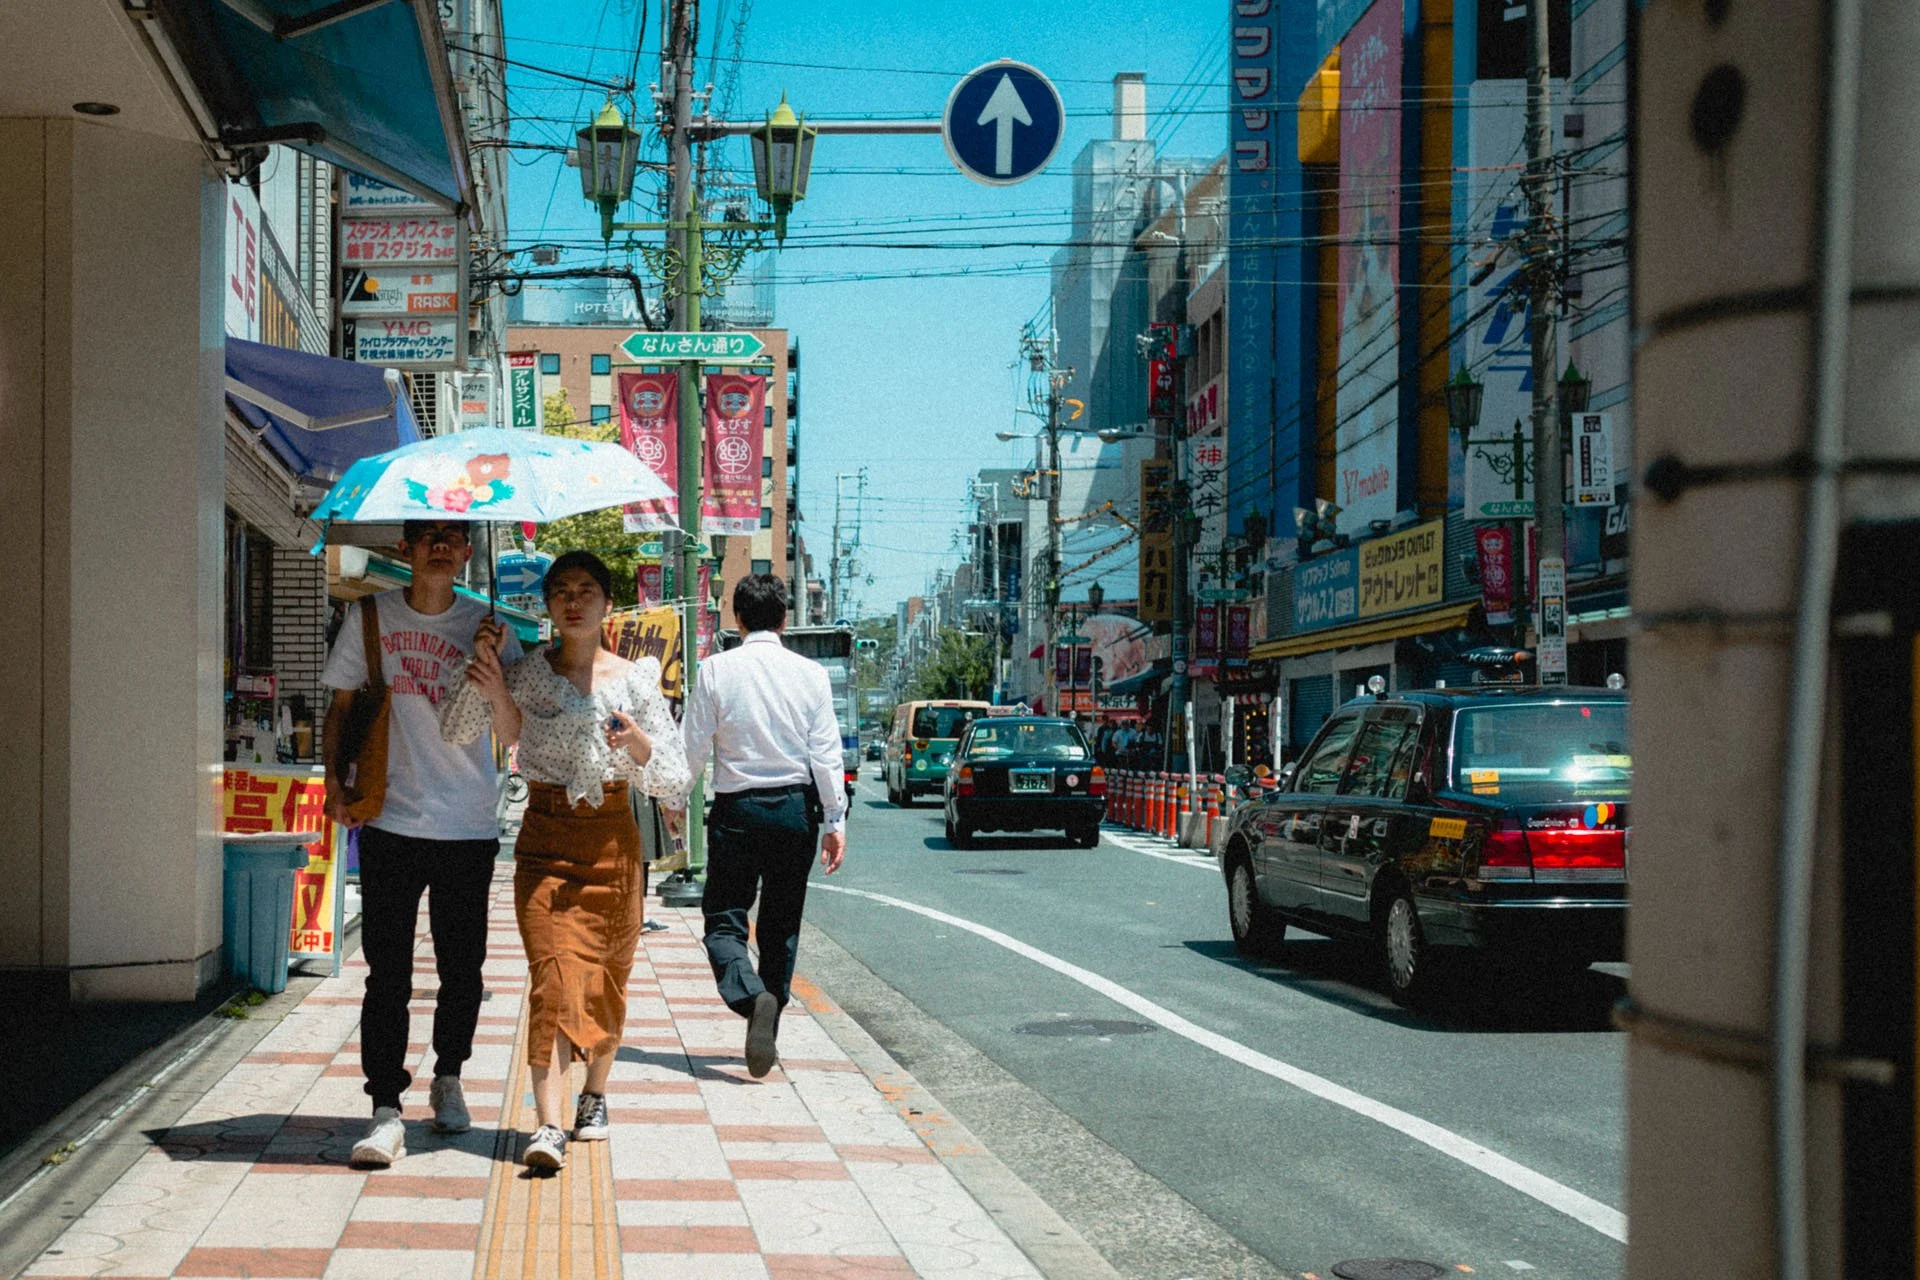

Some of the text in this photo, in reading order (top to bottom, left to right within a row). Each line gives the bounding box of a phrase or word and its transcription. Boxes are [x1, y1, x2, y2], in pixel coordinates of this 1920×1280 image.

[412, 295, 452, 308] RASK
[382, 320, 432, 336] YMC
[360, 336, 454, 348] カイロプラクティックセンター
[642, 337, 746, 354] なんさん通り
[515, 370, 532, 425] アルサンベール
[717, 418, 752, 431] えびす
[401, 656, 440, 681] WORLD
